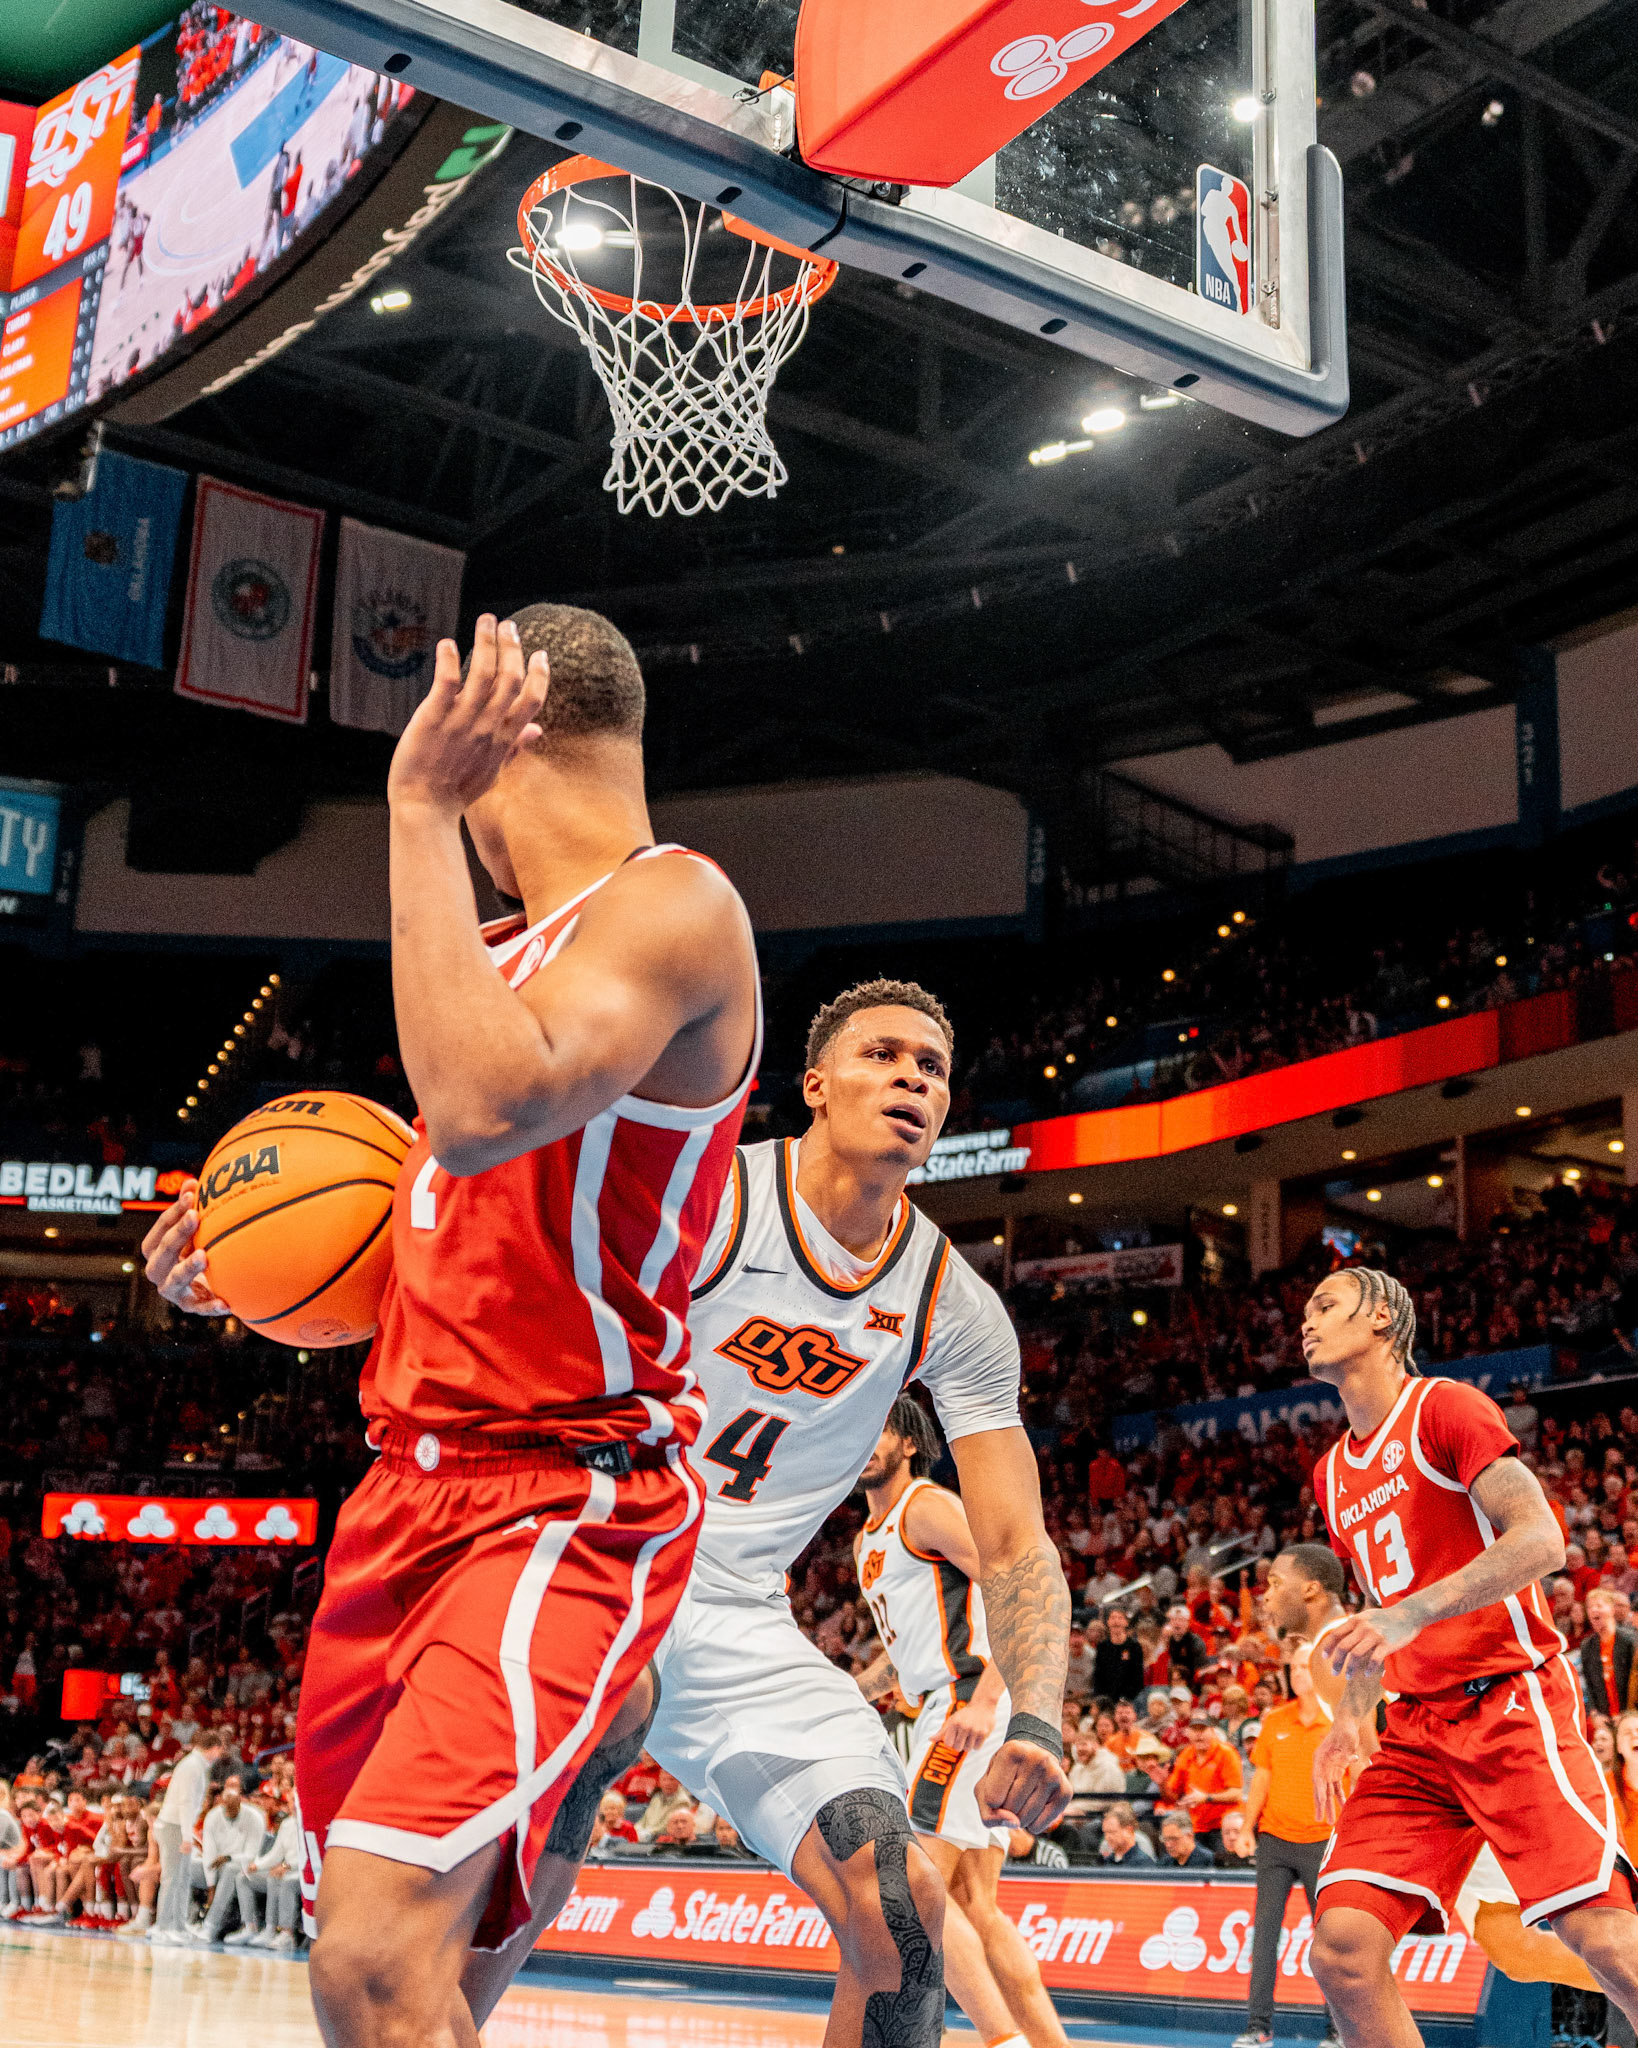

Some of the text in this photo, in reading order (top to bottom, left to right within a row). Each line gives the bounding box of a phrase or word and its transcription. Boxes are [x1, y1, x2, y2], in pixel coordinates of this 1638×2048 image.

[43, 181, 92, 261] 49
[1204, 273, 1232, 306] NBA
[0, 1161, 158, 1201] BEDLAM
[27, 1196, 124, 1214] BASKETBALL
[199, 1145, 280, 1210] NCAA
[713, 1316, 870, 1398] OSU
[703, 1408, 791, 1503] 4
[1383, 1441, 1405, 1472] SEC
[1339, 1474, 1410, 1530] OKLAHOMA
[1353, 1510, 1415, 1606] 13
[550, 1888, 619, 1933] arm
[673, 1888, 831, 1949] StateFarm
[1017, 1903, 1114, 1965] Farm
